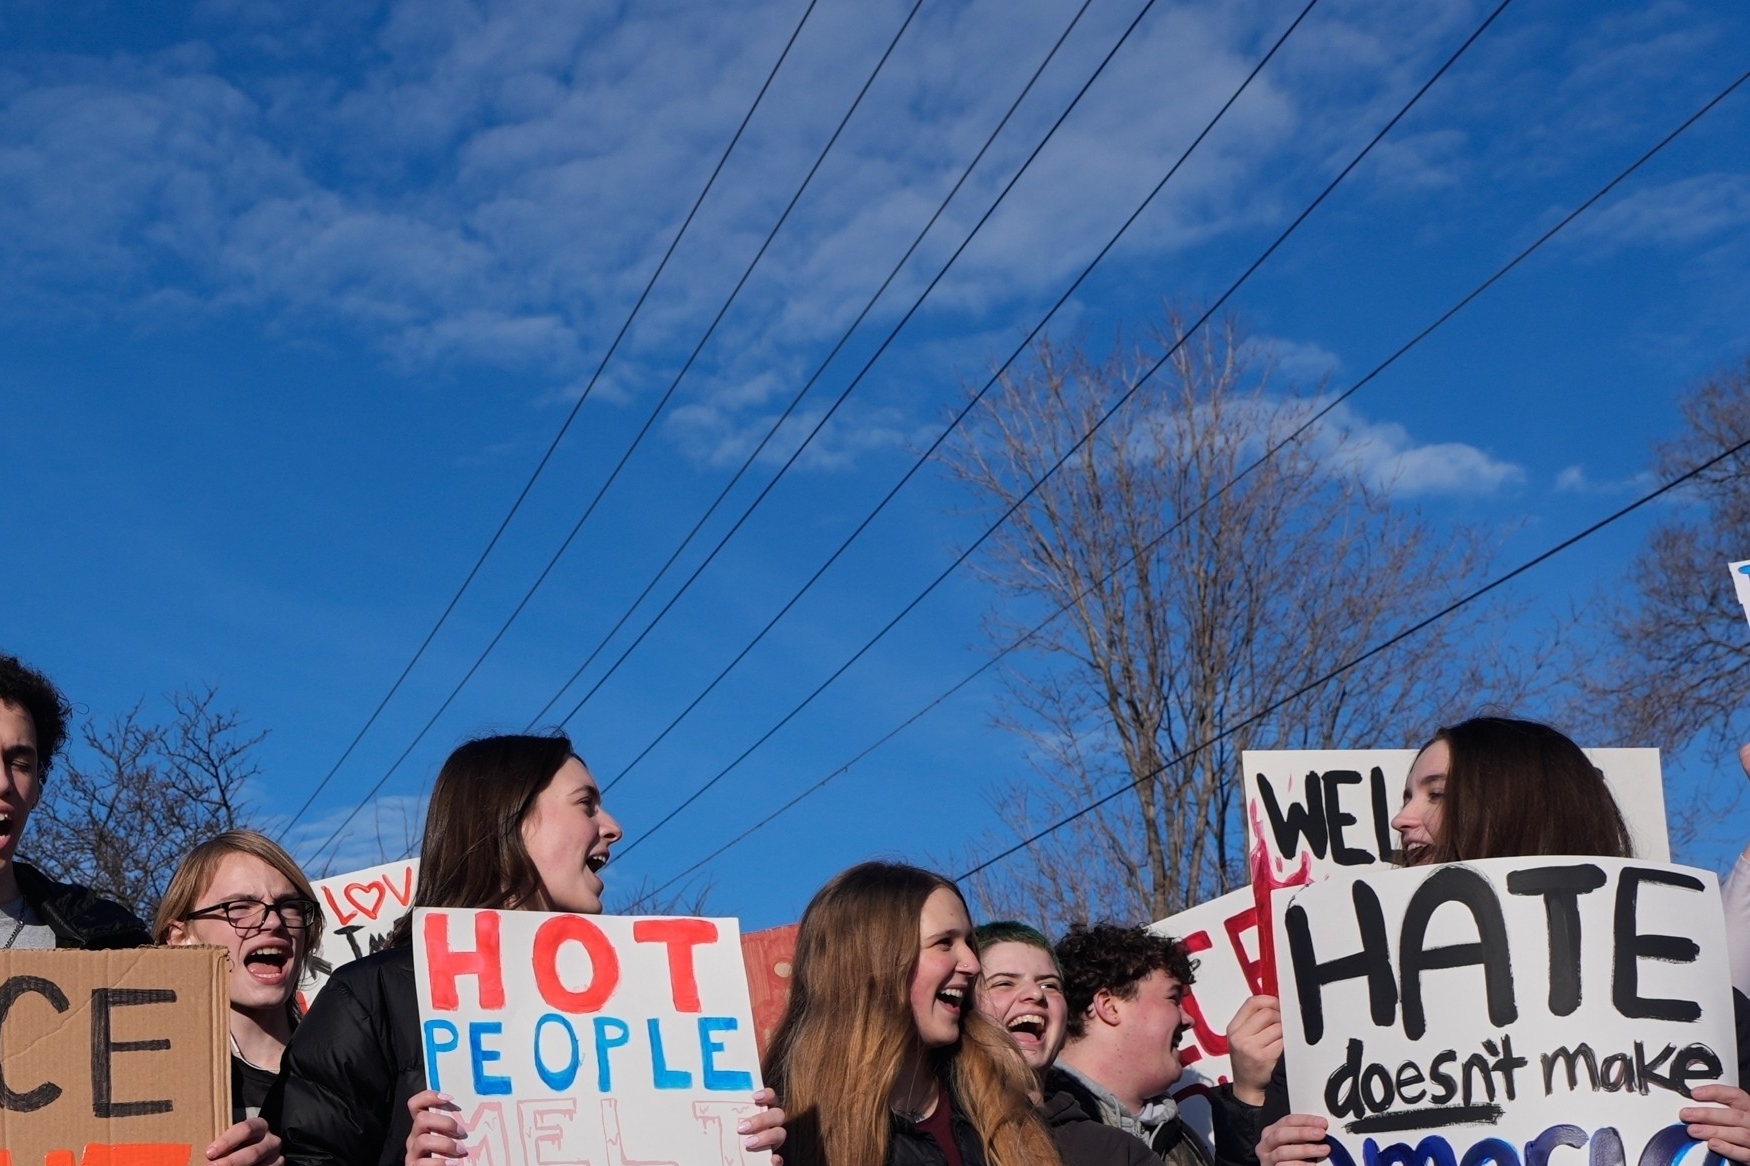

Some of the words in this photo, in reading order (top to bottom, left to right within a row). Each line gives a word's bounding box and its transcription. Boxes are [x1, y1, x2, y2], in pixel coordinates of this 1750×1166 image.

[423, 911, 718, 1013] HOT
[1284, 863, 1705, 1046] HATE
[424, 1013, 753, 1095] PEOPLE
[1324, 1034, 1528, 1119] doesn't
[1540, 1040, 1723, 1099] make
